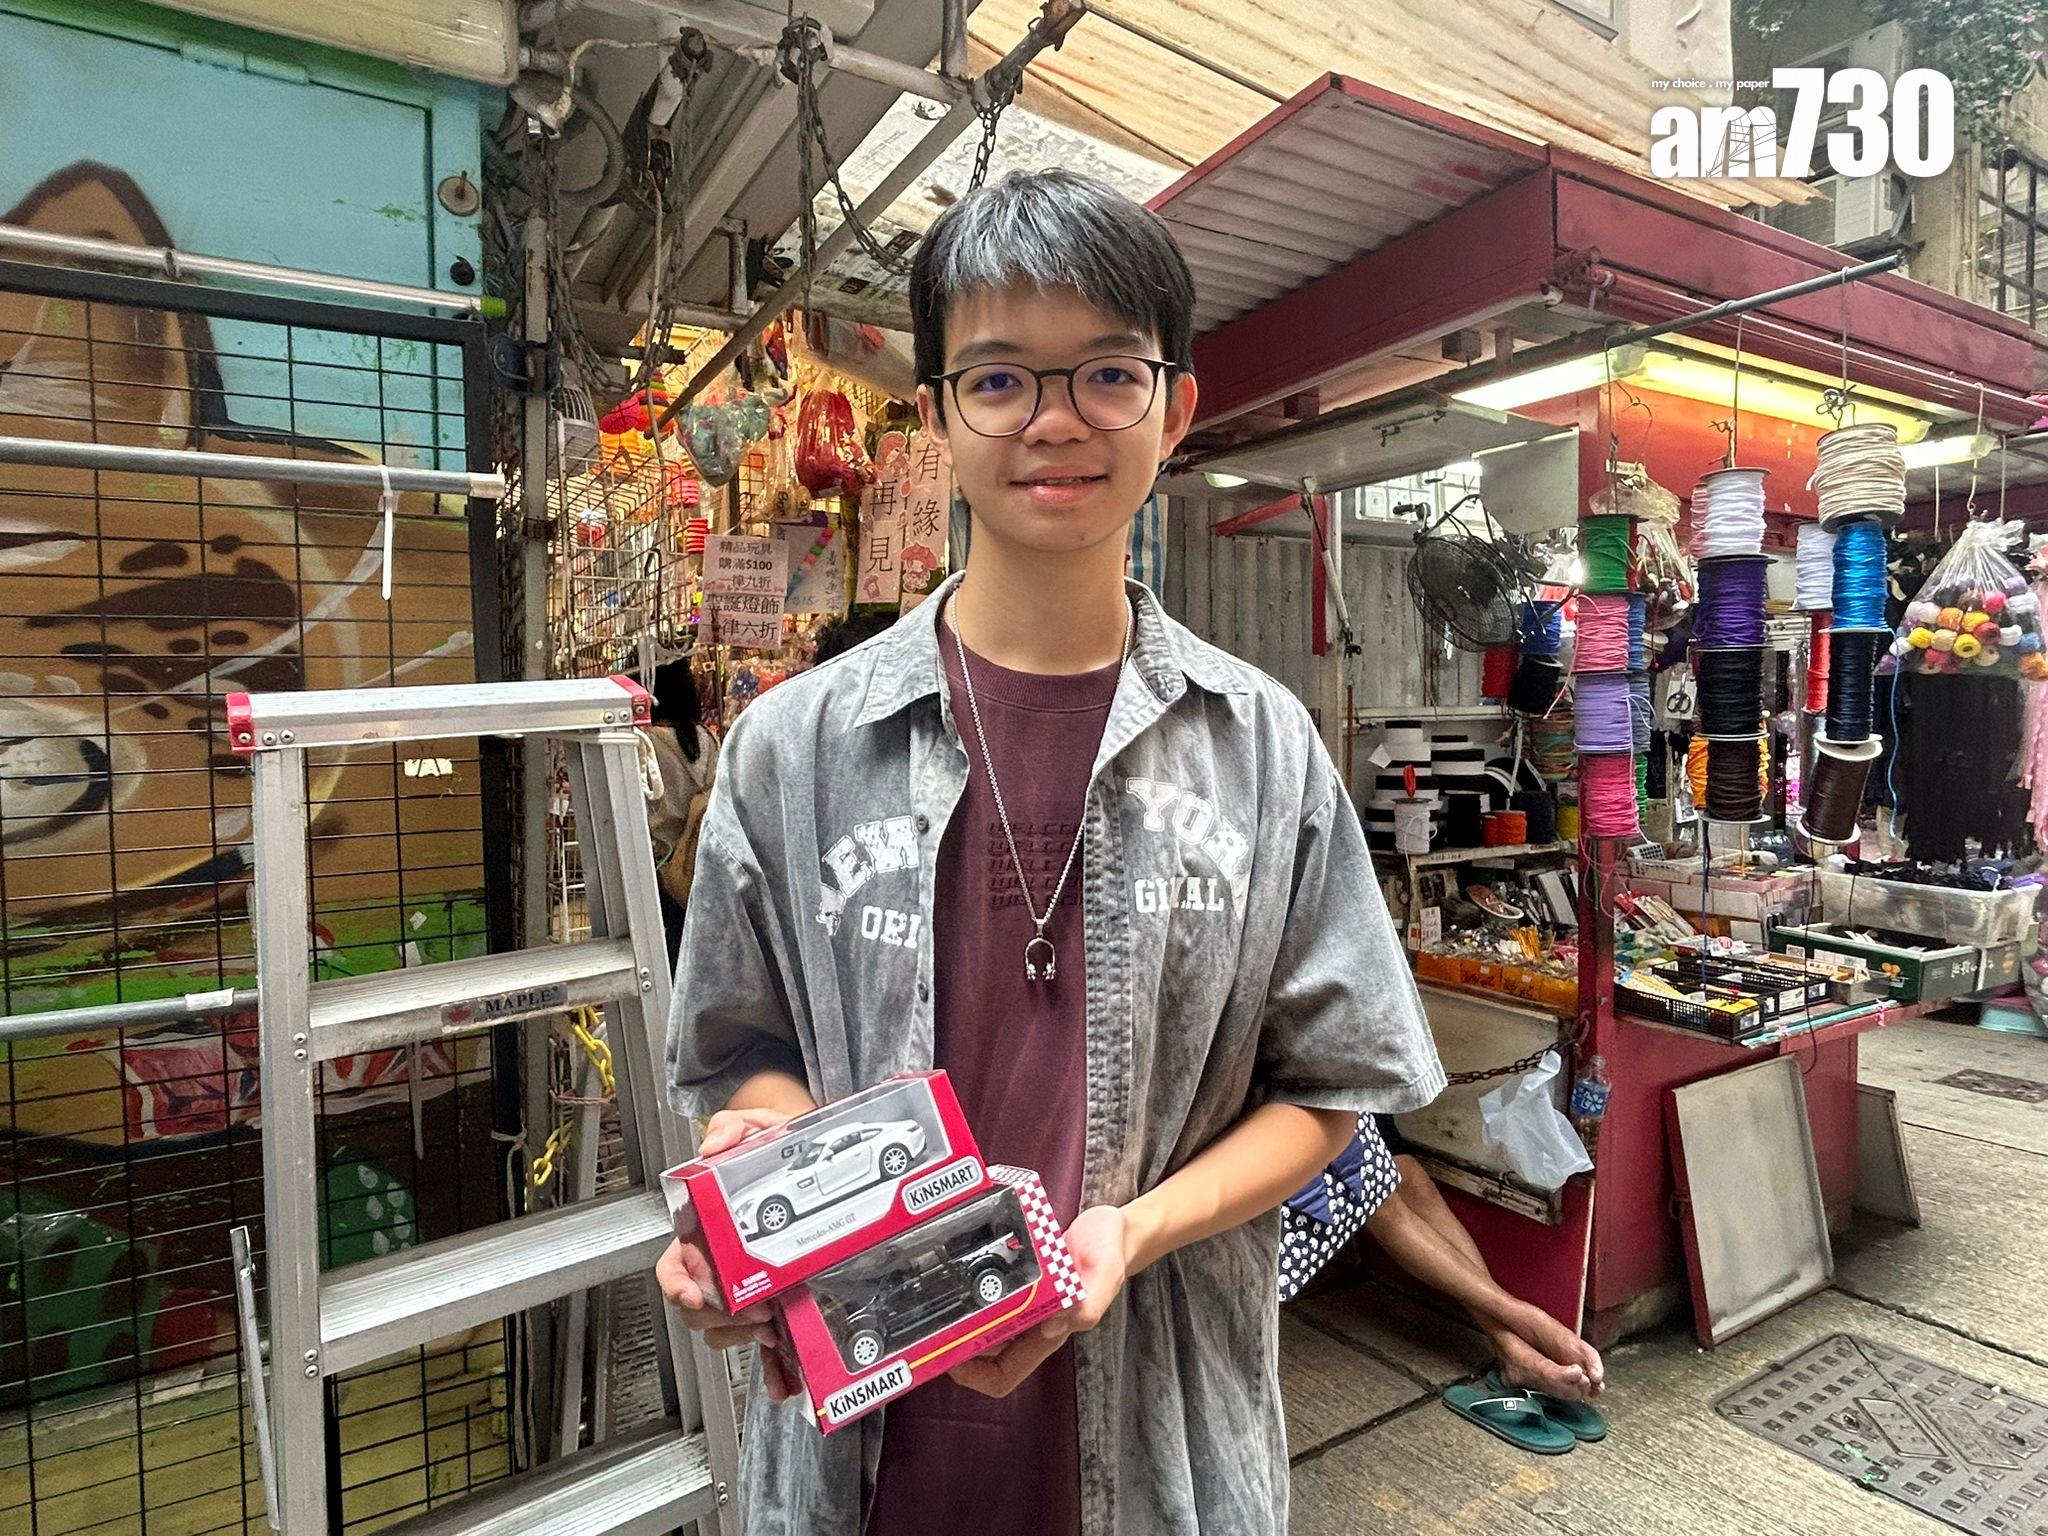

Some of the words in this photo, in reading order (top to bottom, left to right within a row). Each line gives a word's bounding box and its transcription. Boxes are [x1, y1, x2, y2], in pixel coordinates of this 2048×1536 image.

[914, 443, 942, 537] 有緣
[865, 479, 899, 574] 再見
[861, 905, 922, 949] ORI
[781, 1141, 806, 1160] GT
